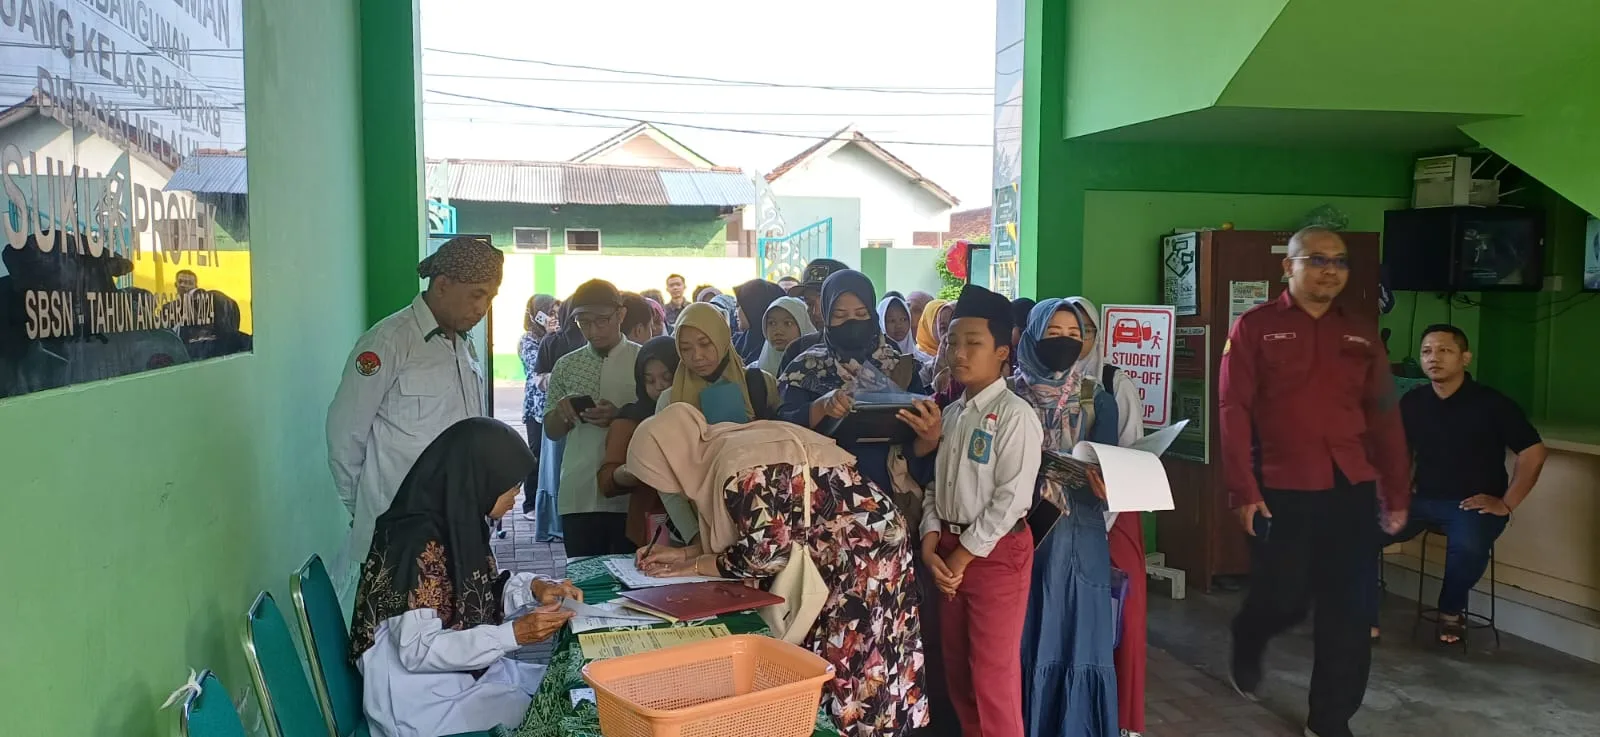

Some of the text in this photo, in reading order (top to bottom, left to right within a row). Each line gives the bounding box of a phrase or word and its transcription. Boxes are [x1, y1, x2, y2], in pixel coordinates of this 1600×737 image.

[81, 22, 147, 98] KELAS
[152, 65, 192, 123] BARU
[196, 93, 221, 137] RKB
[2, 143, 219, 268] SUKUK PROYEK
[25, 289, 73, 340] SBSN
[87, 291, 134, 334] TAHUN
[136, 292, 195, 332] ANGGARAN
[197, 293, 215, 325] 2024
[1112, 351, 1161, 368] STUDENT
